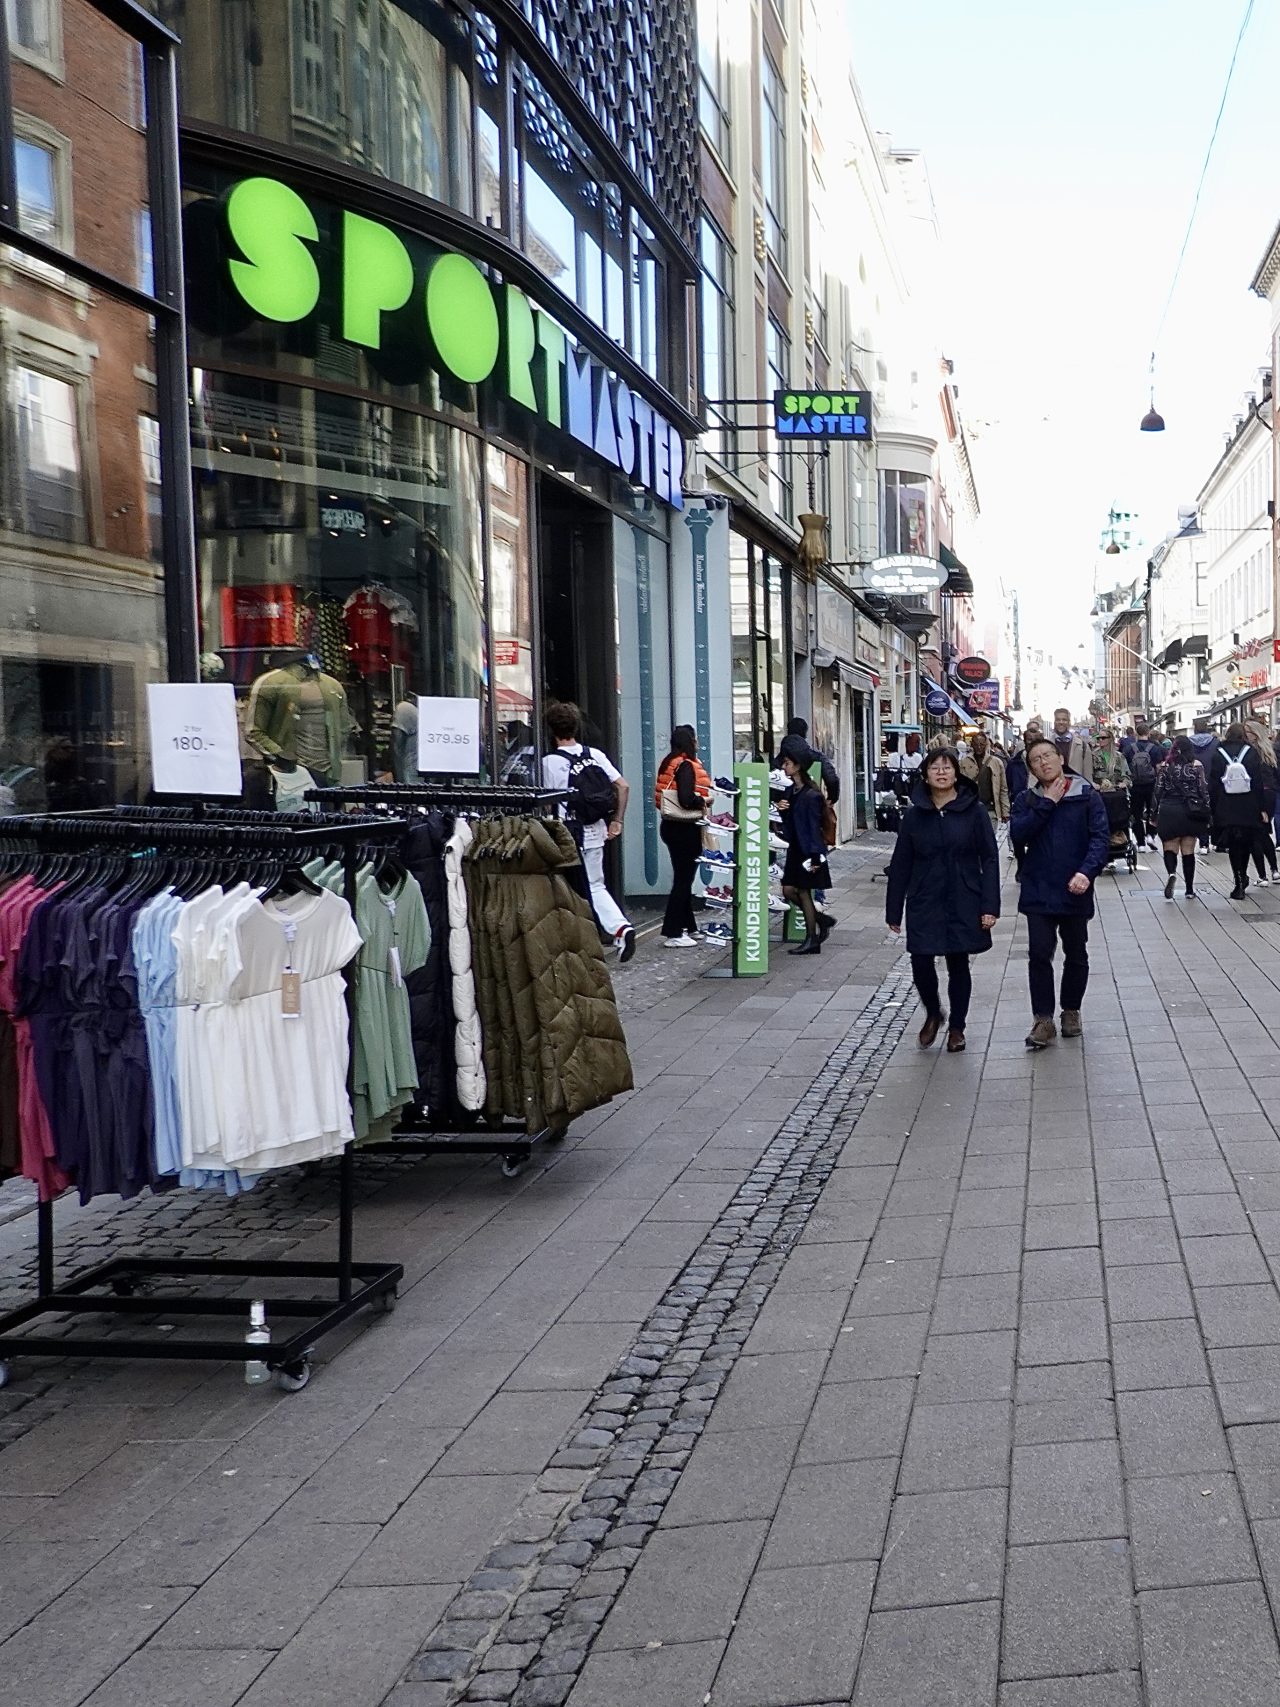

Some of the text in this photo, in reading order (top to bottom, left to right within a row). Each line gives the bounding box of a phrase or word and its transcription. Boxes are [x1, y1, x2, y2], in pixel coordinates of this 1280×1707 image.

[784, 395, 860, 414] SPORT
[778, 416, 867, 434] MASTER
[172, 736, 215, 750] 180.-
[427, 733, 471, 744] 379.95
[746, 776, 762, 962] KUNDERNES FAVORIT
